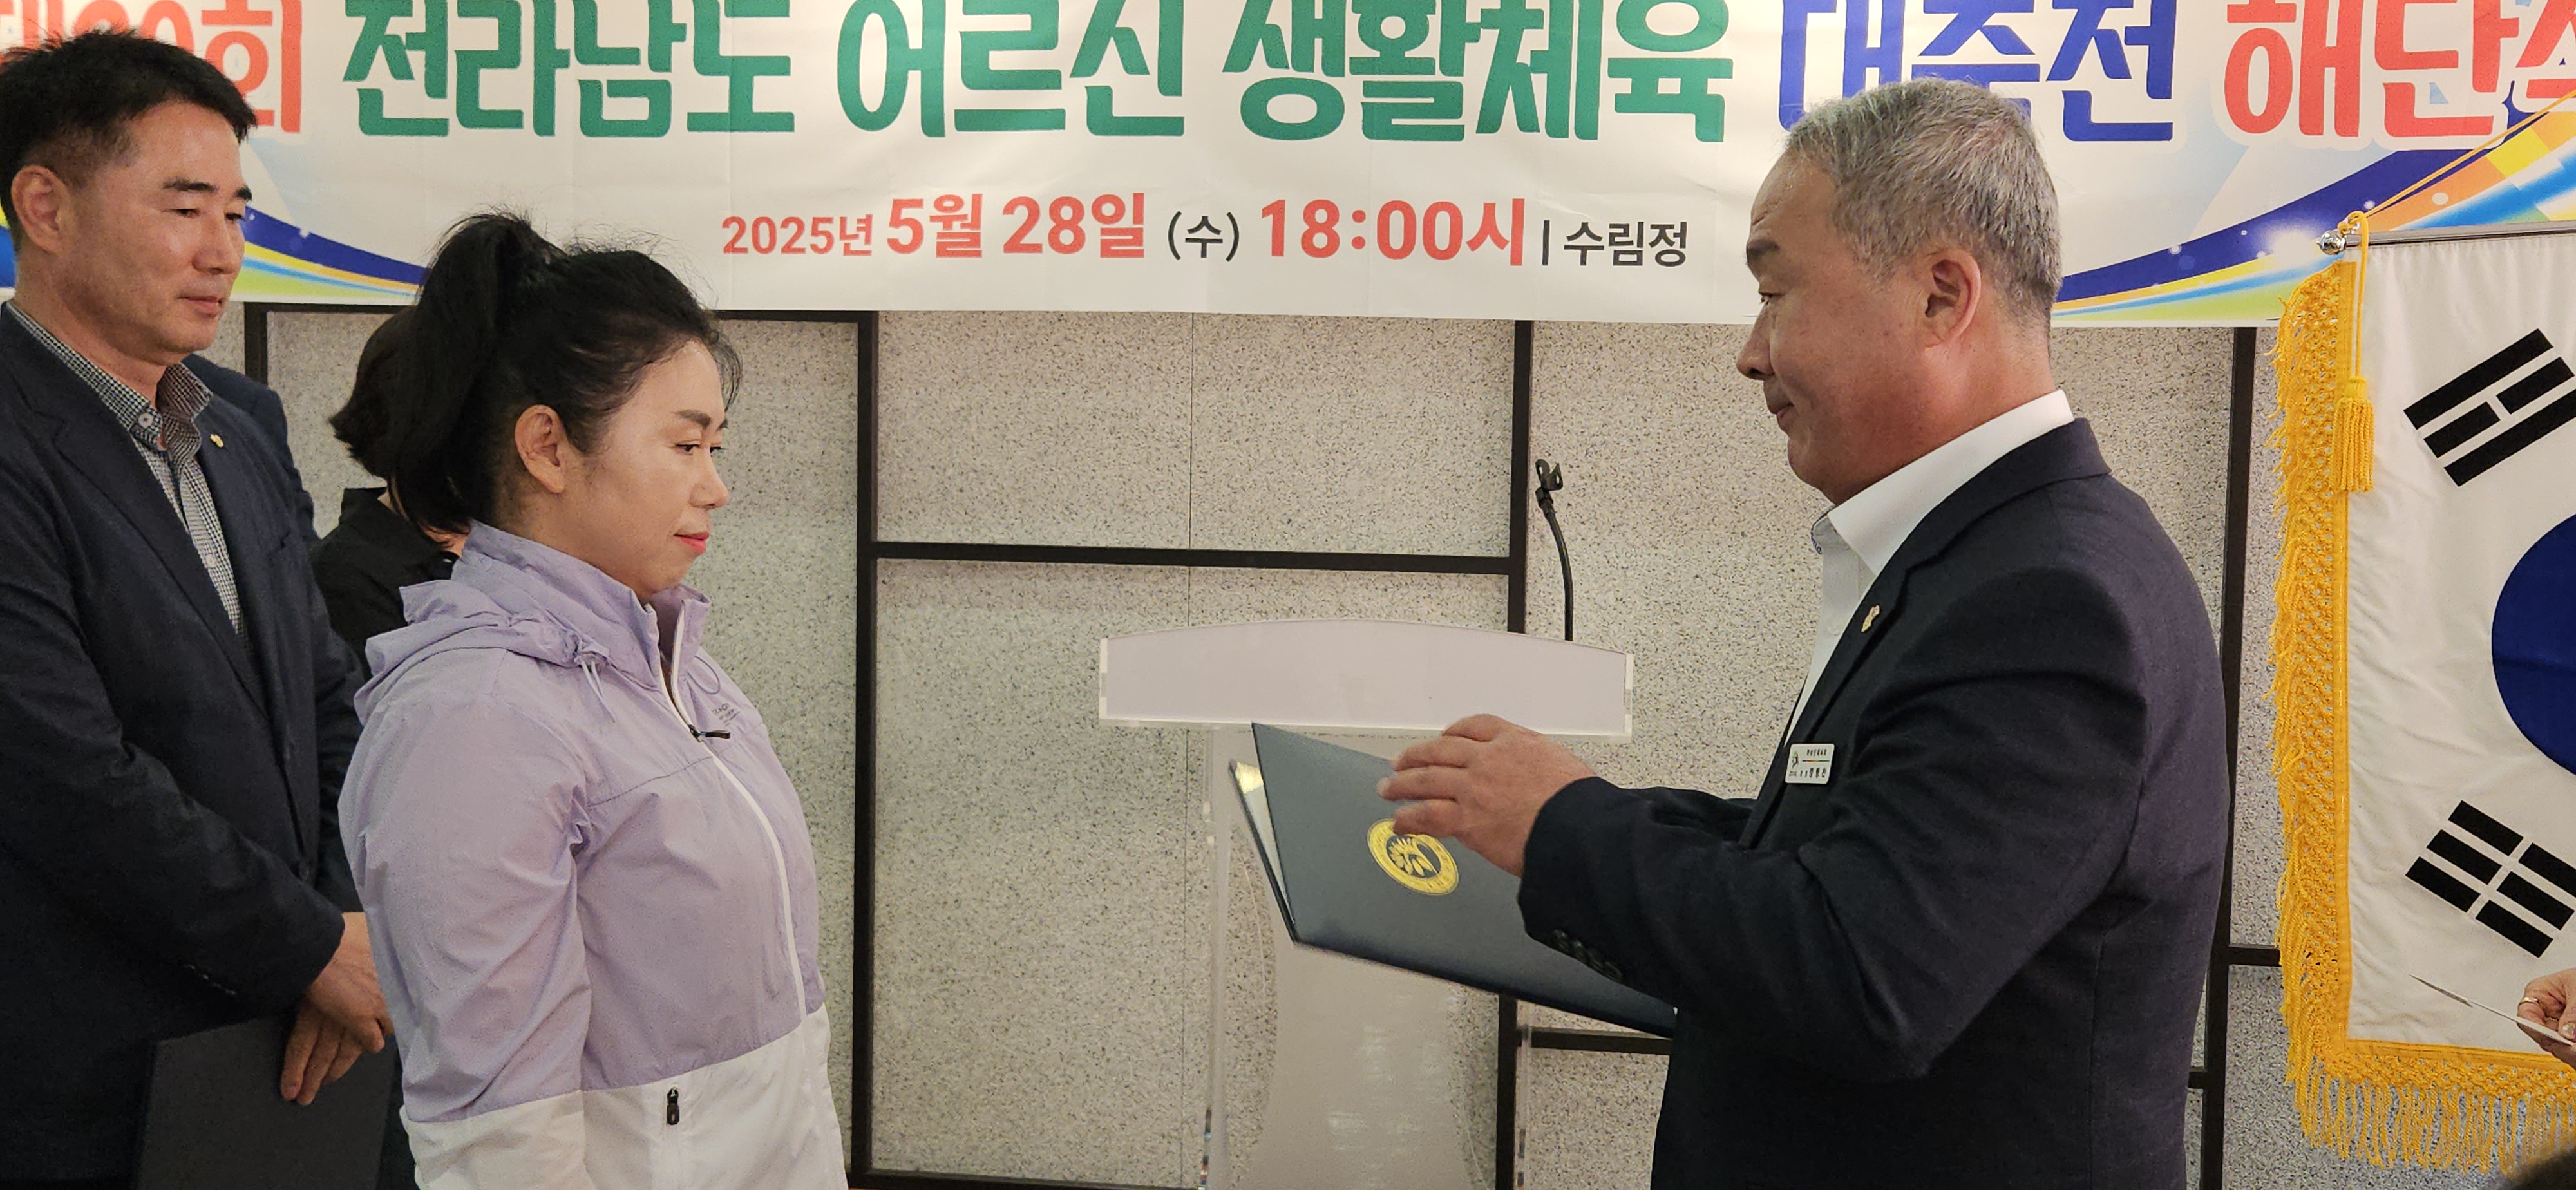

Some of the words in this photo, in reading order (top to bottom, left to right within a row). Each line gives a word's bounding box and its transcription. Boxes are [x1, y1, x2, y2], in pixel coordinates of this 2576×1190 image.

[343, 0, 795, 137] 전라남도
[837, 0, 1185, 137] 어르신
[1222, 0, 1732, 142] 생활체육
[721, 214, 873, 257] 2025년
[887, 193, 983, 258] 5월
[1002, 192, 1146, 258] 28일
[1167, 210, 1240, 263] (수)
[1261, 198, 1525, 267] 18:00시
[1563, 220, 1688, 268] 수림정
